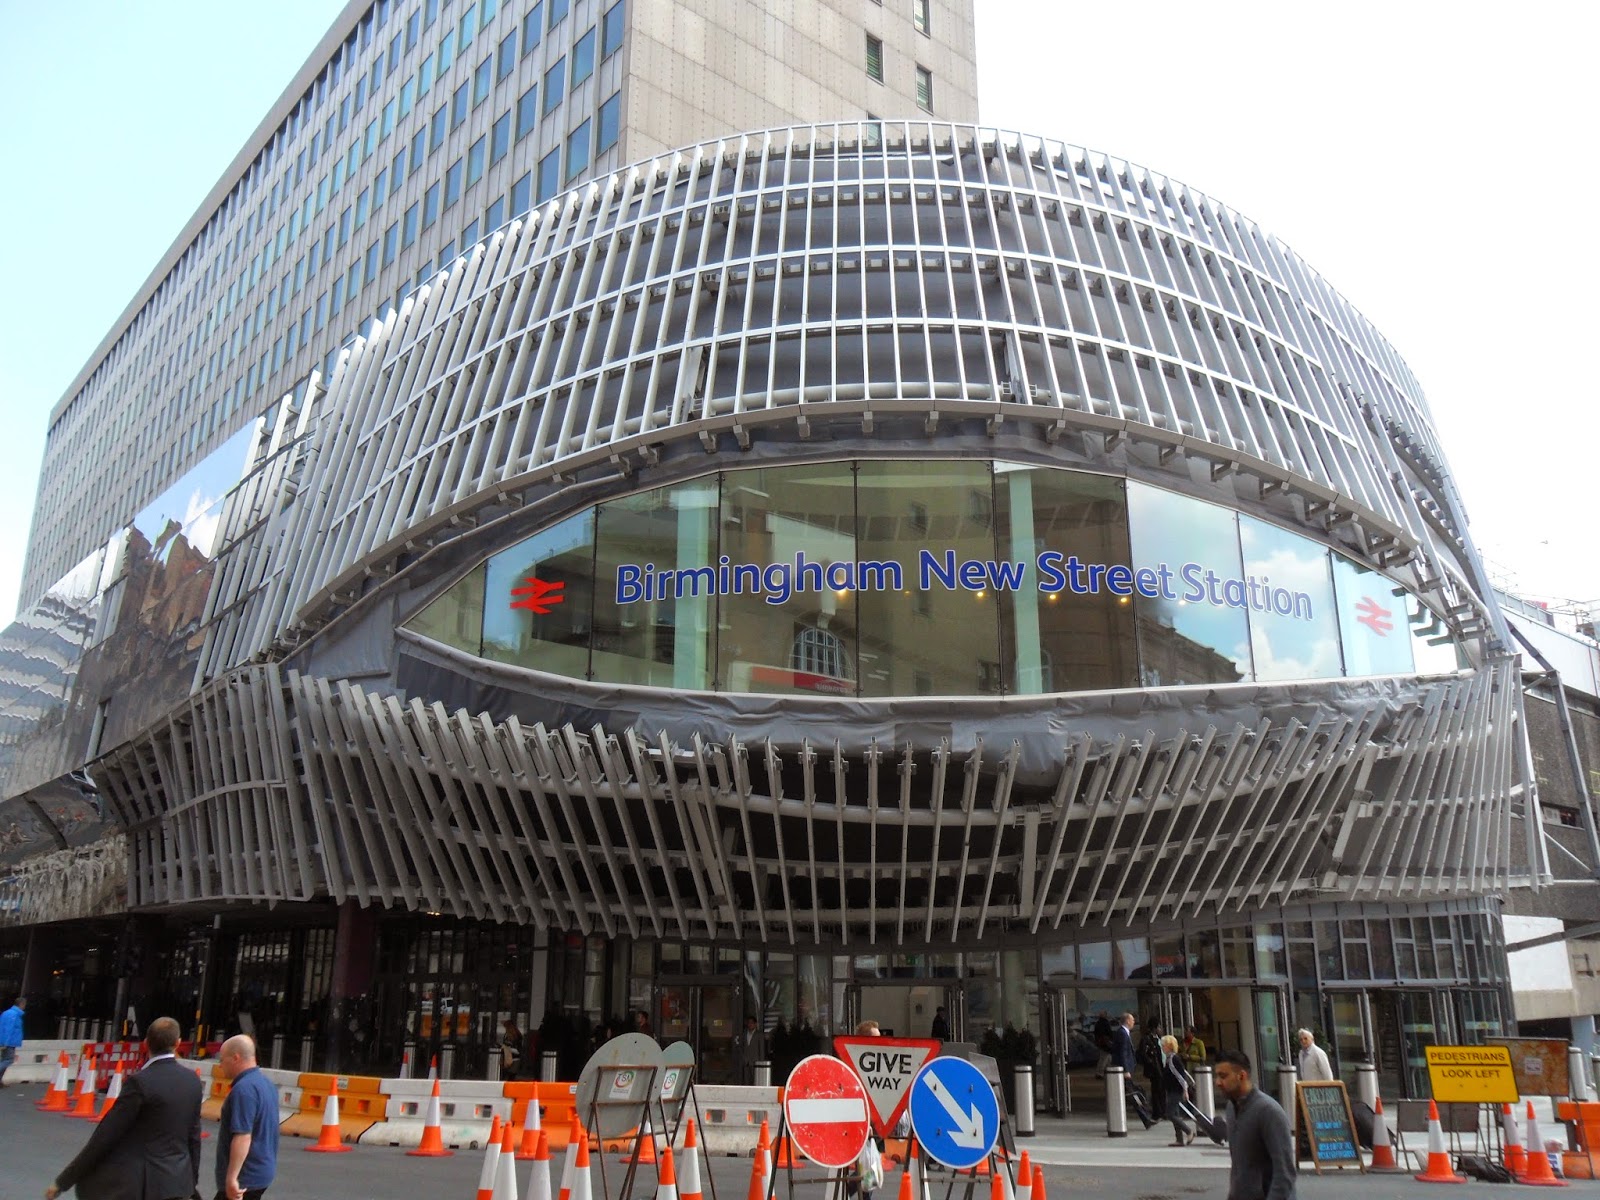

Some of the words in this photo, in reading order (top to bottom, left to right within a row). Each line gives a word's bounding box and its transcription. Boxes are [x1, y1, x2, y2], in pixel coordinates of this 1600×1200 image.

[615, 551, 904, 606] Birmingham
[918, 549, 1025, 592] New
[1035, 551, 1176, 600] Street
[1180, 562, 1313, 621] Station
[859, 1052, 912, 1075] GIVE
[1430, 1052, 1505, 1061] PEDESTRIANS
[1442, 1069, 1472, 1078] LOOK
[1475, 1069, 1500, 1078] LEFT
[867, 1076, 901, 1090] WAY
